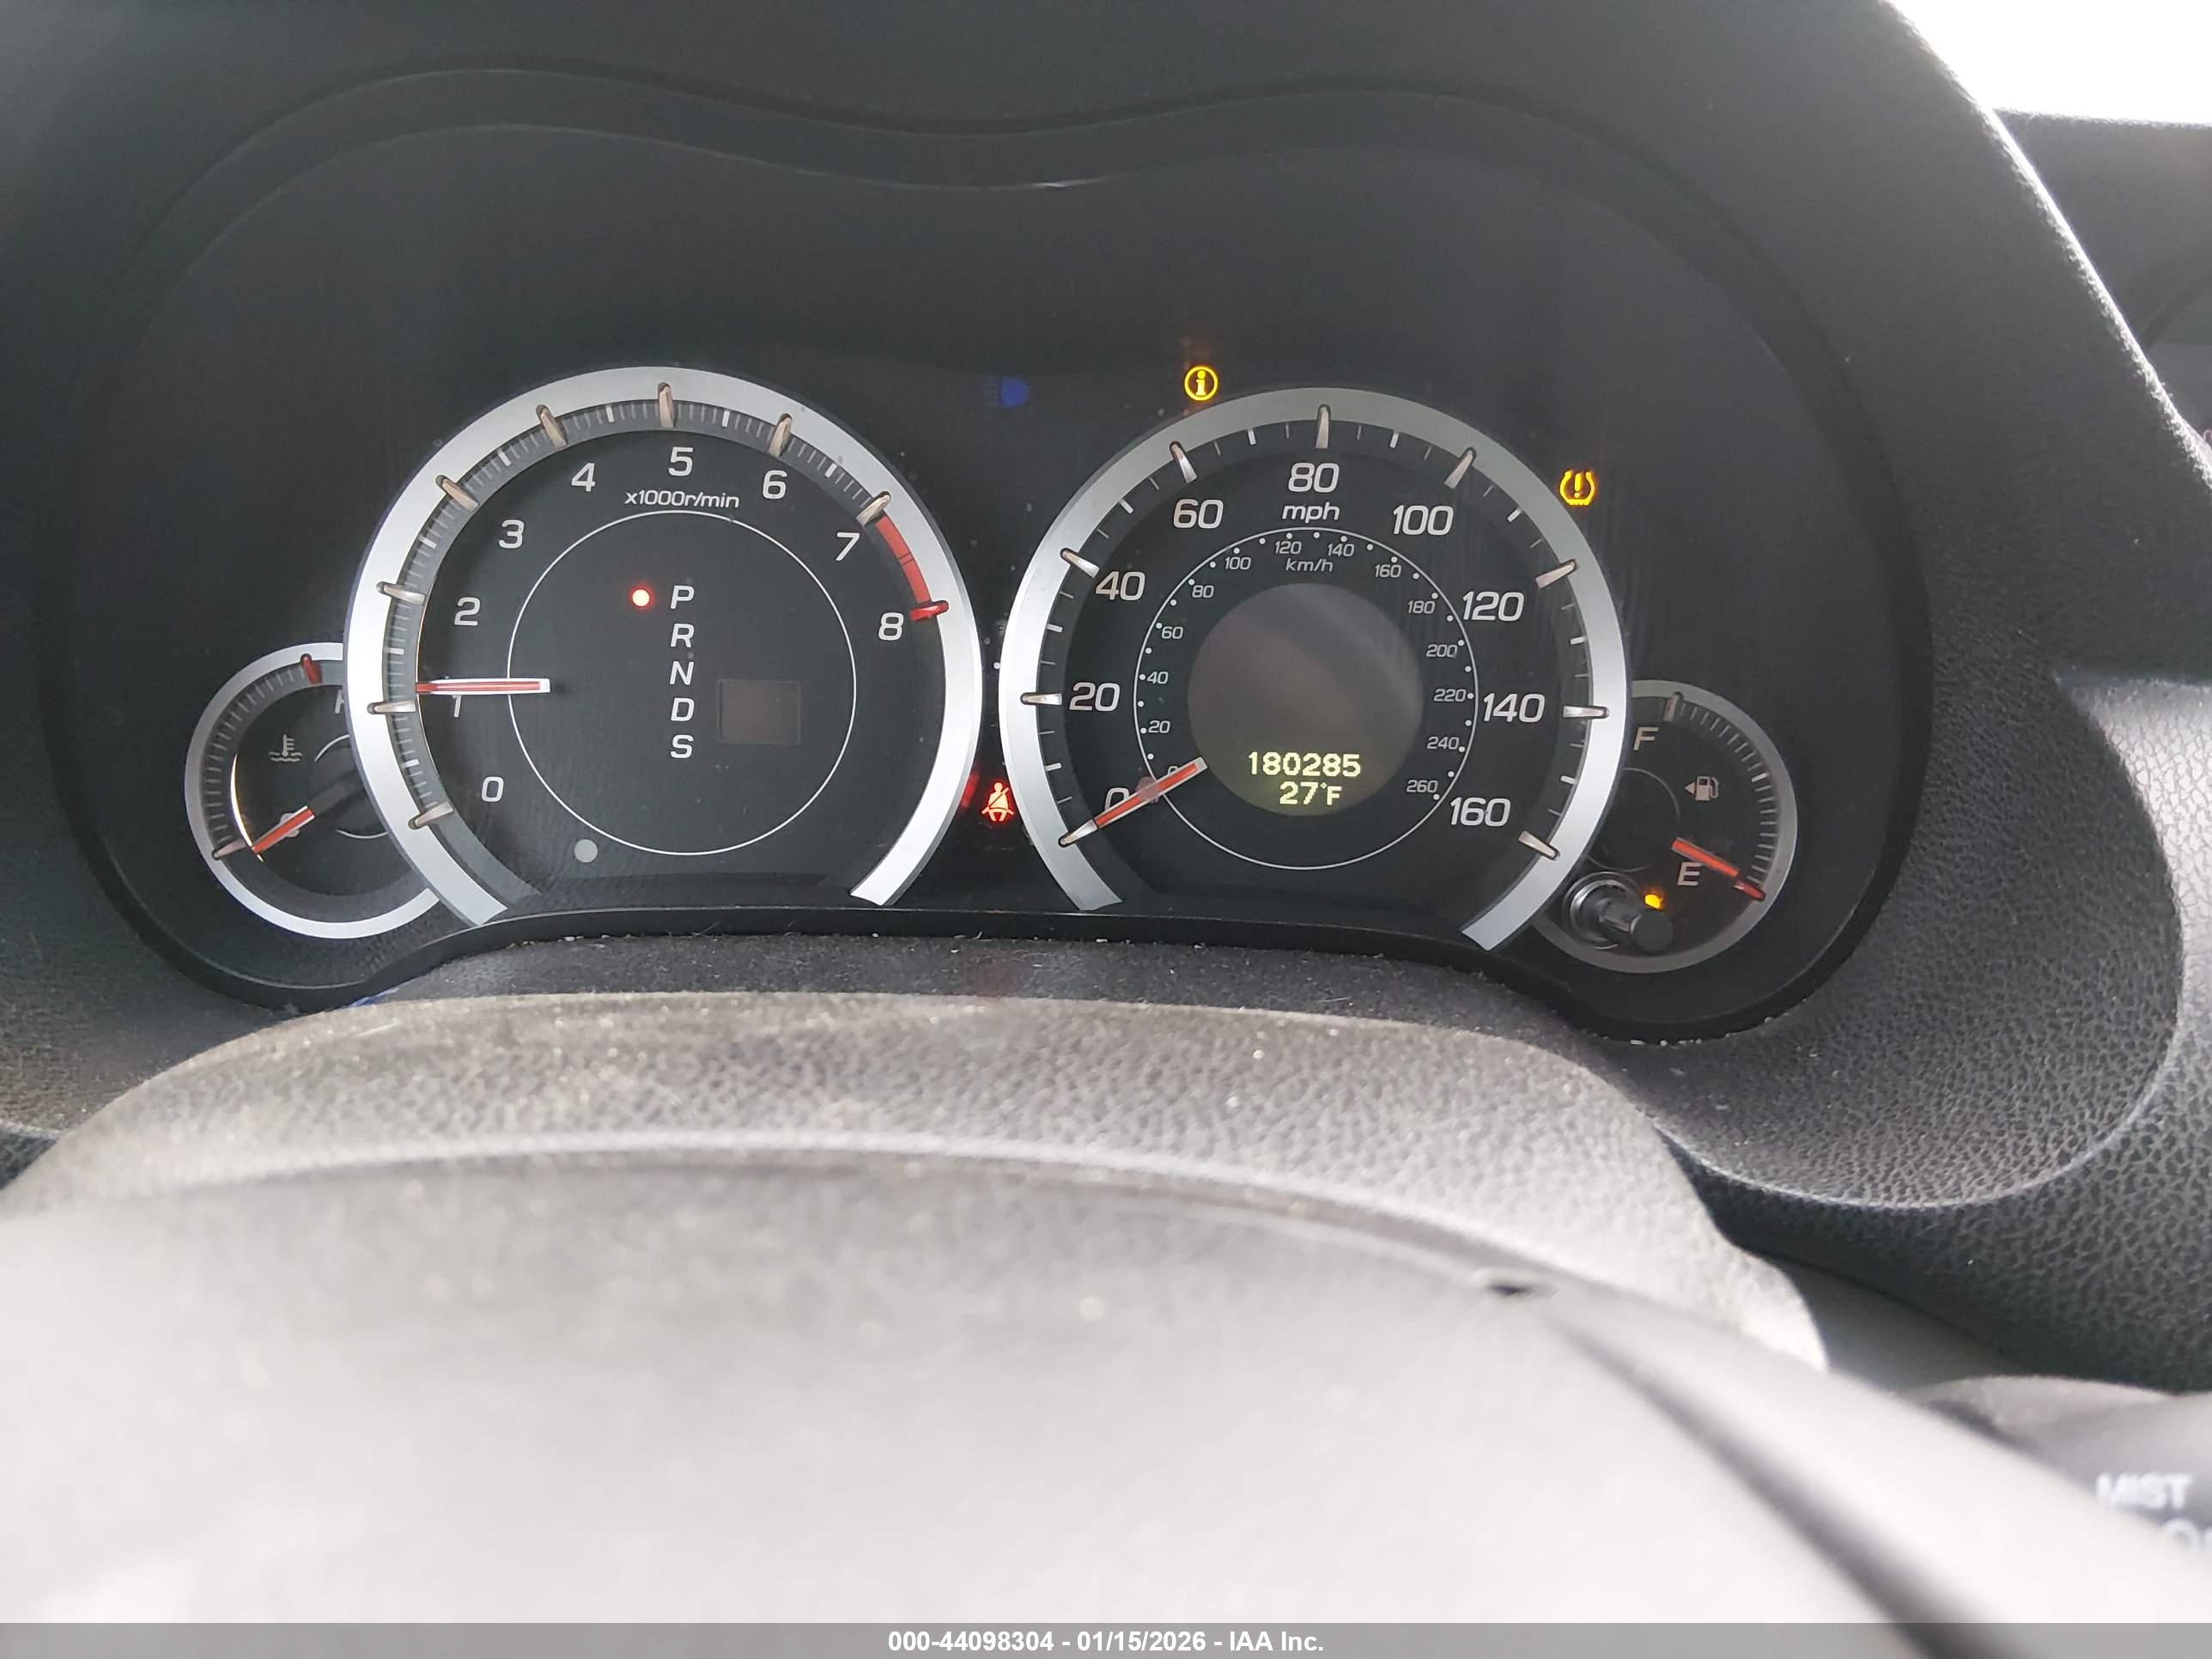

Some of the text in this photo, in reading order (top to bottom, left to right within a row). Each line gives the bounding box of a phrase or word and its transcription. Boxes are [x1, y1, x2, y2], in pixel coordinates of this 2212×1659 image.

[669, 447, 693, 476] 5
[572, 463, 595, 491] 4
[763, 471, 787, 499] 6
[1289, 463, 1339, 492] 80
[625, 490, 739, 507] x1000r/min
[1174, 499, 1223, 528] 60
[1282, 504, 1340, 524] mph
[1394, 505, 1453, 535] 100
[499, 520, 524, 548] 3
[836, 532, 860, 561] 7
[1276, 541, 1302, 554] 120
[1328, 544, 1354, 556] 140
[1225, 556, 1251, 569] 100
[1286, 558, 1333, 572] km/h
[1376, 564, 1401, 577] 160
[1096, 571, 1145, 600] 40
[1192, 585, 1215, 599] 80
[671, 586, 694, 609] P
[1408, 601, 1435, 614] 180
[1463, 592, 1524, 621] 120
[454, 598, 480, 626] 2
[671, 623, 694, 647] R
[878, 612, 903, 641] 8
[1162, 626, 1183, 640] 60
[1426, 644, 1457, 657] 200
[670, 661, 694, 684] N
[1147, 672, 1168, 684] 40
[1069, 683, 1120, 711] 20
[1434, 689, 1465, 702] 220
[671, 698, 694, 721] D
[1484, 693, 1545, 722] 140
[1148, 720, 1170, 733] 20
[671, 735, 693, 758] S
[1427, 737, 1458, 750] 240
[1633, 727, 1658, 750] F
[1249, 752, 1360, 776] 180285
[482, 777, 503, 801] 0
[1407, 780, 1437, 793] 260
[1451, 798, 1510, 826] 160
[1677, 861, 1703, 886] E
